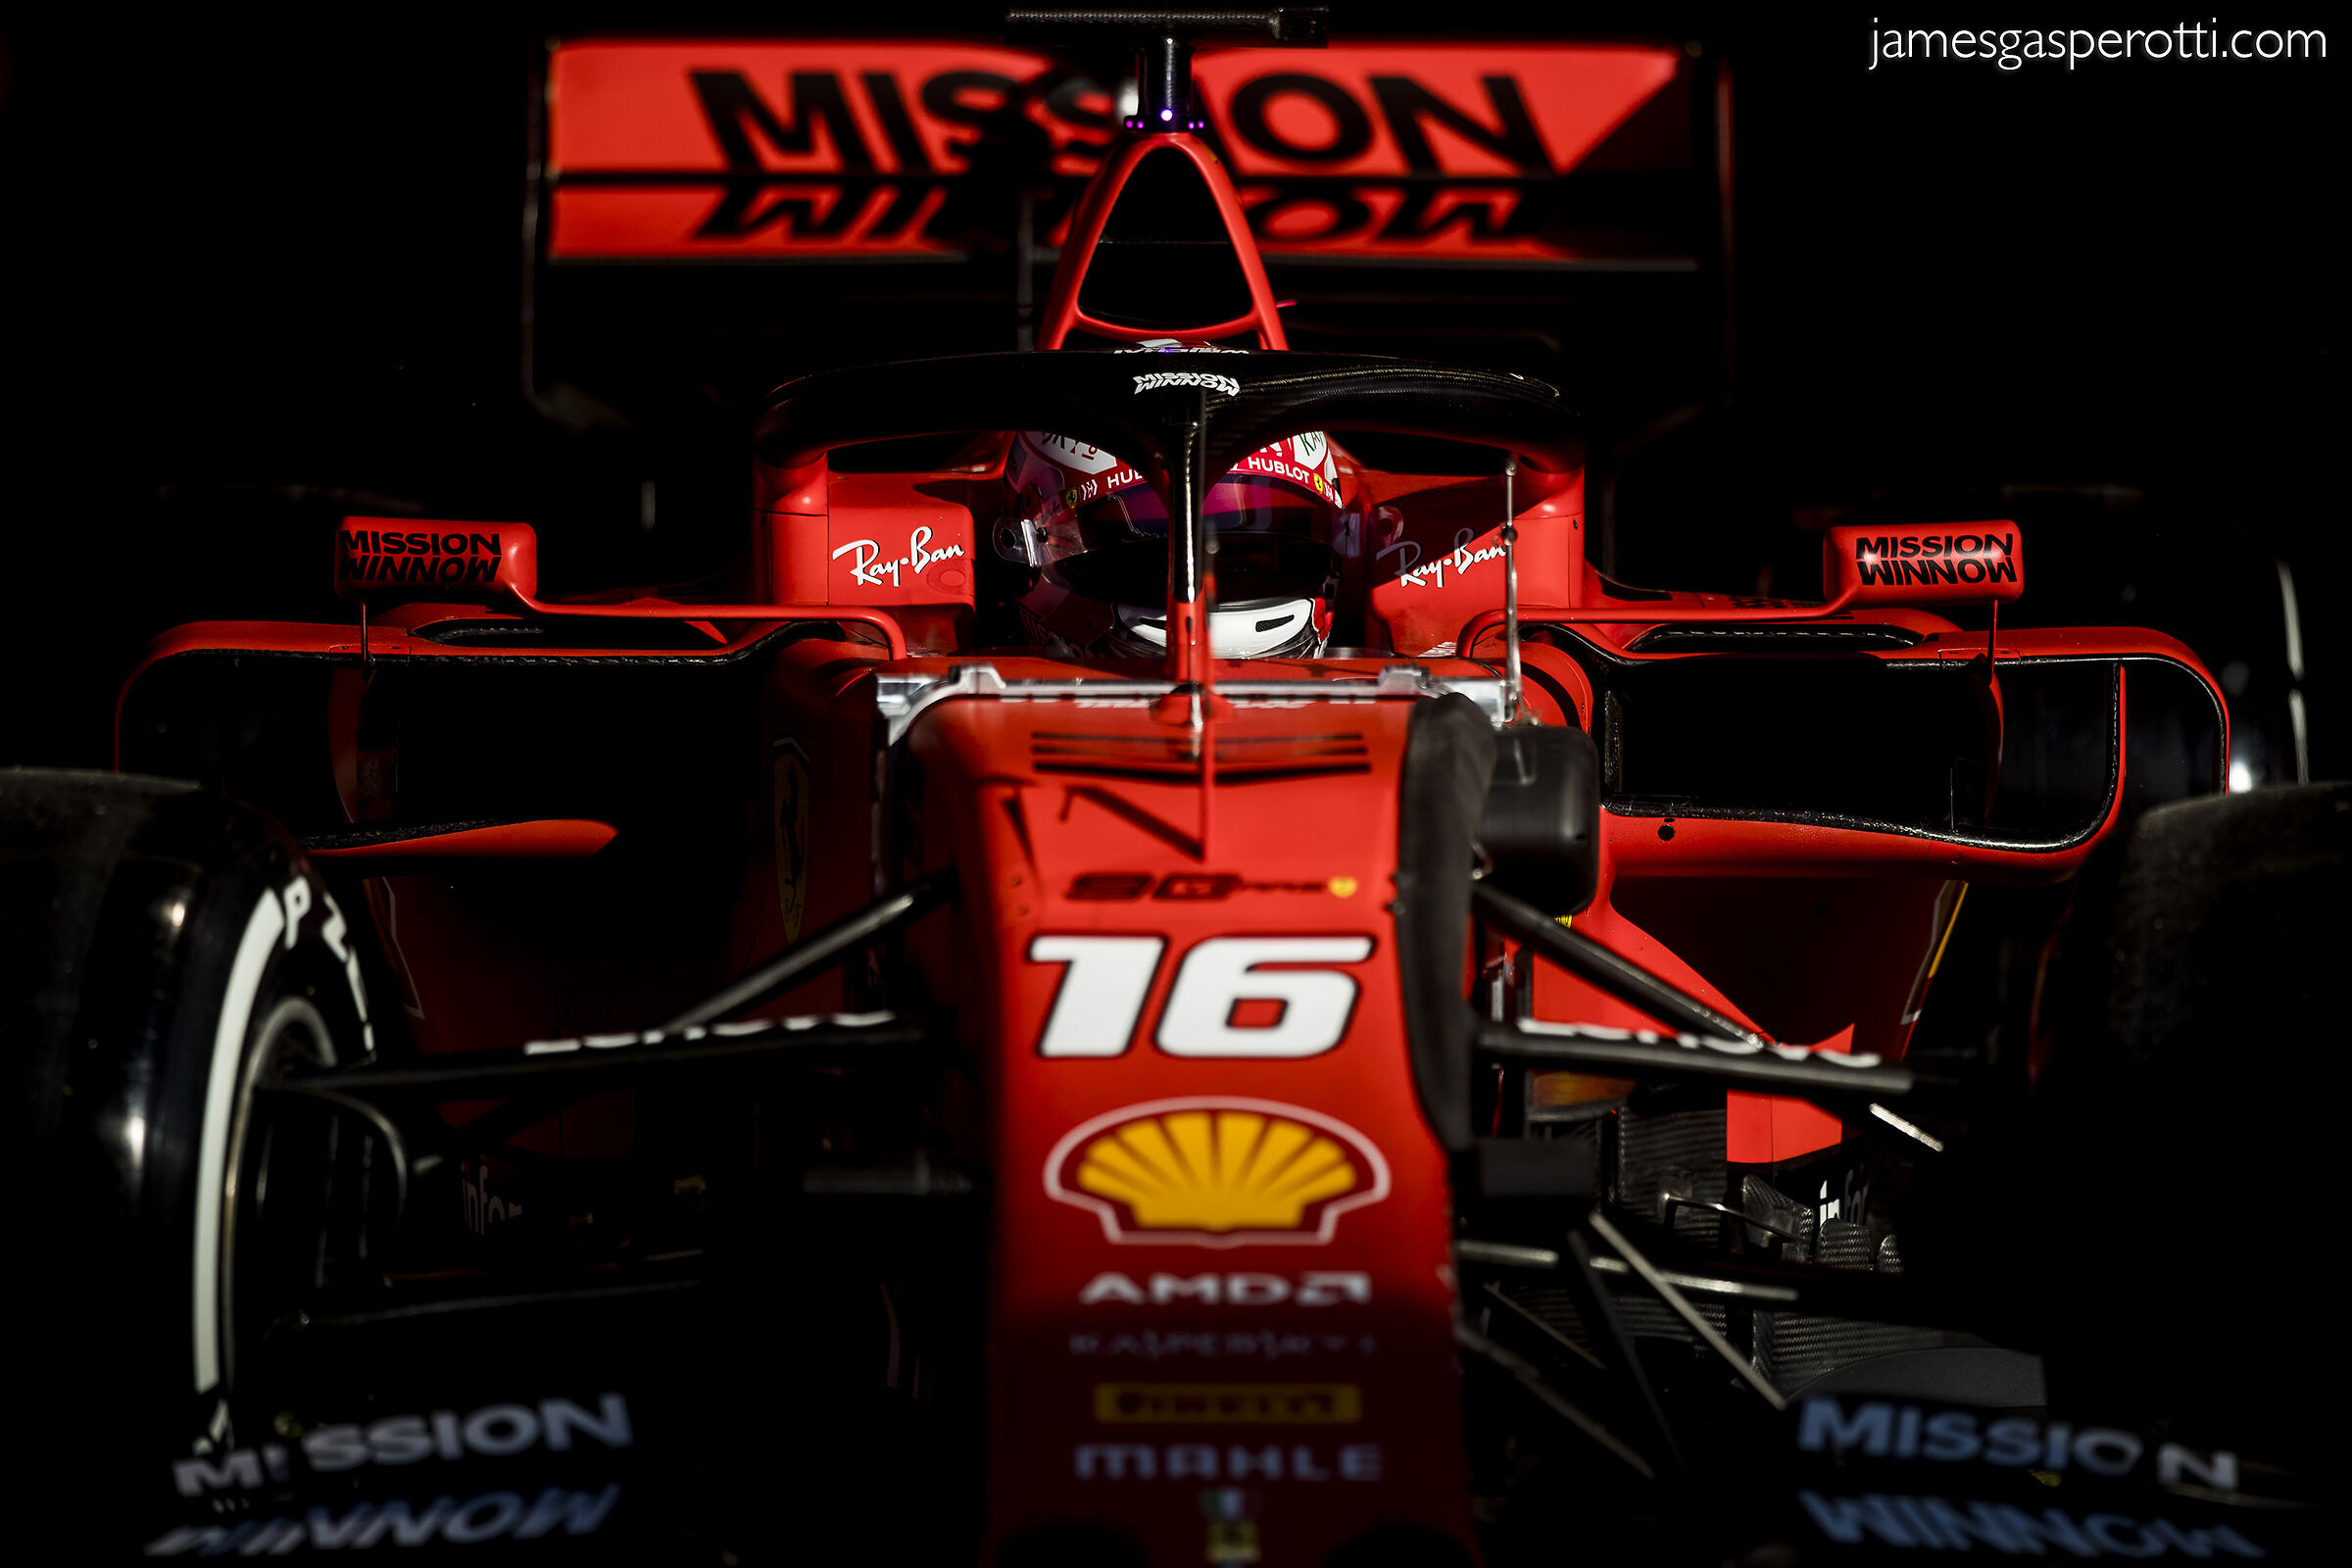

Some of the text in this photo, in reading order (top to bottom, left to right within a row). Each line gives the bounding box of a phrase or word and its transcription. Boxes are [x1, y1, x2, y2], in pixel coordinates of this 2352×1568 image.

[1248, 456, 1310, 485] HUBLOT
[340, 530, 502, 556] MISSION
[1856, 532, 2014, 560] MISSION
[338, 555, 502, 582] WINNOW
[1856, 556, 2018, 586] WINNOW
[1027, 933, 1375, 1059] 16
[1078, 1271, 1291, 1305] AMD
[172, 1391, 635, 1498] MISSION
[1795, 1395, 2241, 1493] MISSION
[1074, 1444, 1384, 1481] MAHLE
